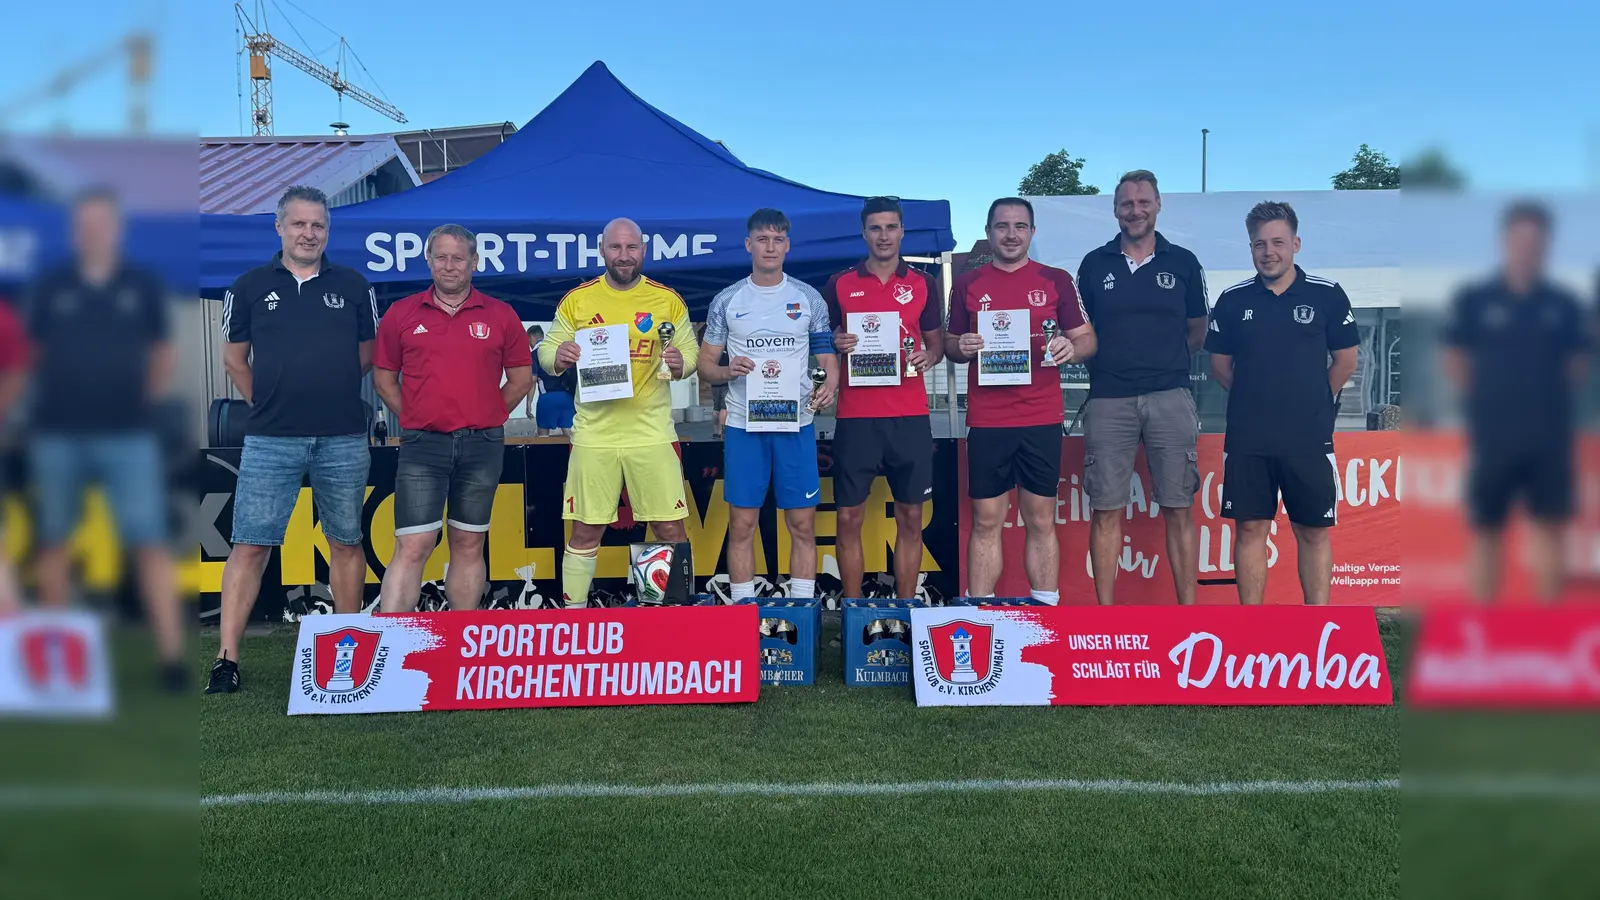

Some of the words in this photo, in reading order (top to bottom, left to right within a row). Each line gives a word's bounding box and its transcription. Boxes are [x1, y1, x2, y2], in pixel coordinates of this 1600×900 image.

[364, 231, 718, 273] SPRT-THME
[1103, 281, 1115, 291] MB
[849, 290, 866, 299] JAKO
[267, 301, 278, 311] GF
[1241, 309, 1254, 322] JR
[746, 337, 795, 348] novem
[566, 496, 575, 514] 1
[1199, 519, 1279, 573] LLS
[1367, 563, 1401, 574] Verpac
[1330, 576, 1380, 587] Wellpappe
[460, 621, 625, 658] SPORTCLUB
[1068, 634, 1112, 650] UNSER
[1115, 634, 1150, 650] HERZ
[1168, 621, 1382, 690] Dumba
[301, 647, 314, 696] SPORTCLUB
[311, 693, 327, 704] e.V.
[330, 646, 390, 704] KIRCHENTHUMBACH
[855, 668, 909, 682] KULMBACH
[919, 639, 940, 688] SPORTCLUB
[938, 685, 955, 696] e.V.
[958, 638, 1005, 696] KIRCHENTHUMBACH
[1072, 660, 1131, 679] SCHLÄGT
[1134, 660, 1161, 679] FÜR
[455, 659, 742, 700] KIRCHENTHUMBACH
[760, 669, 804, 682] MBACHER
